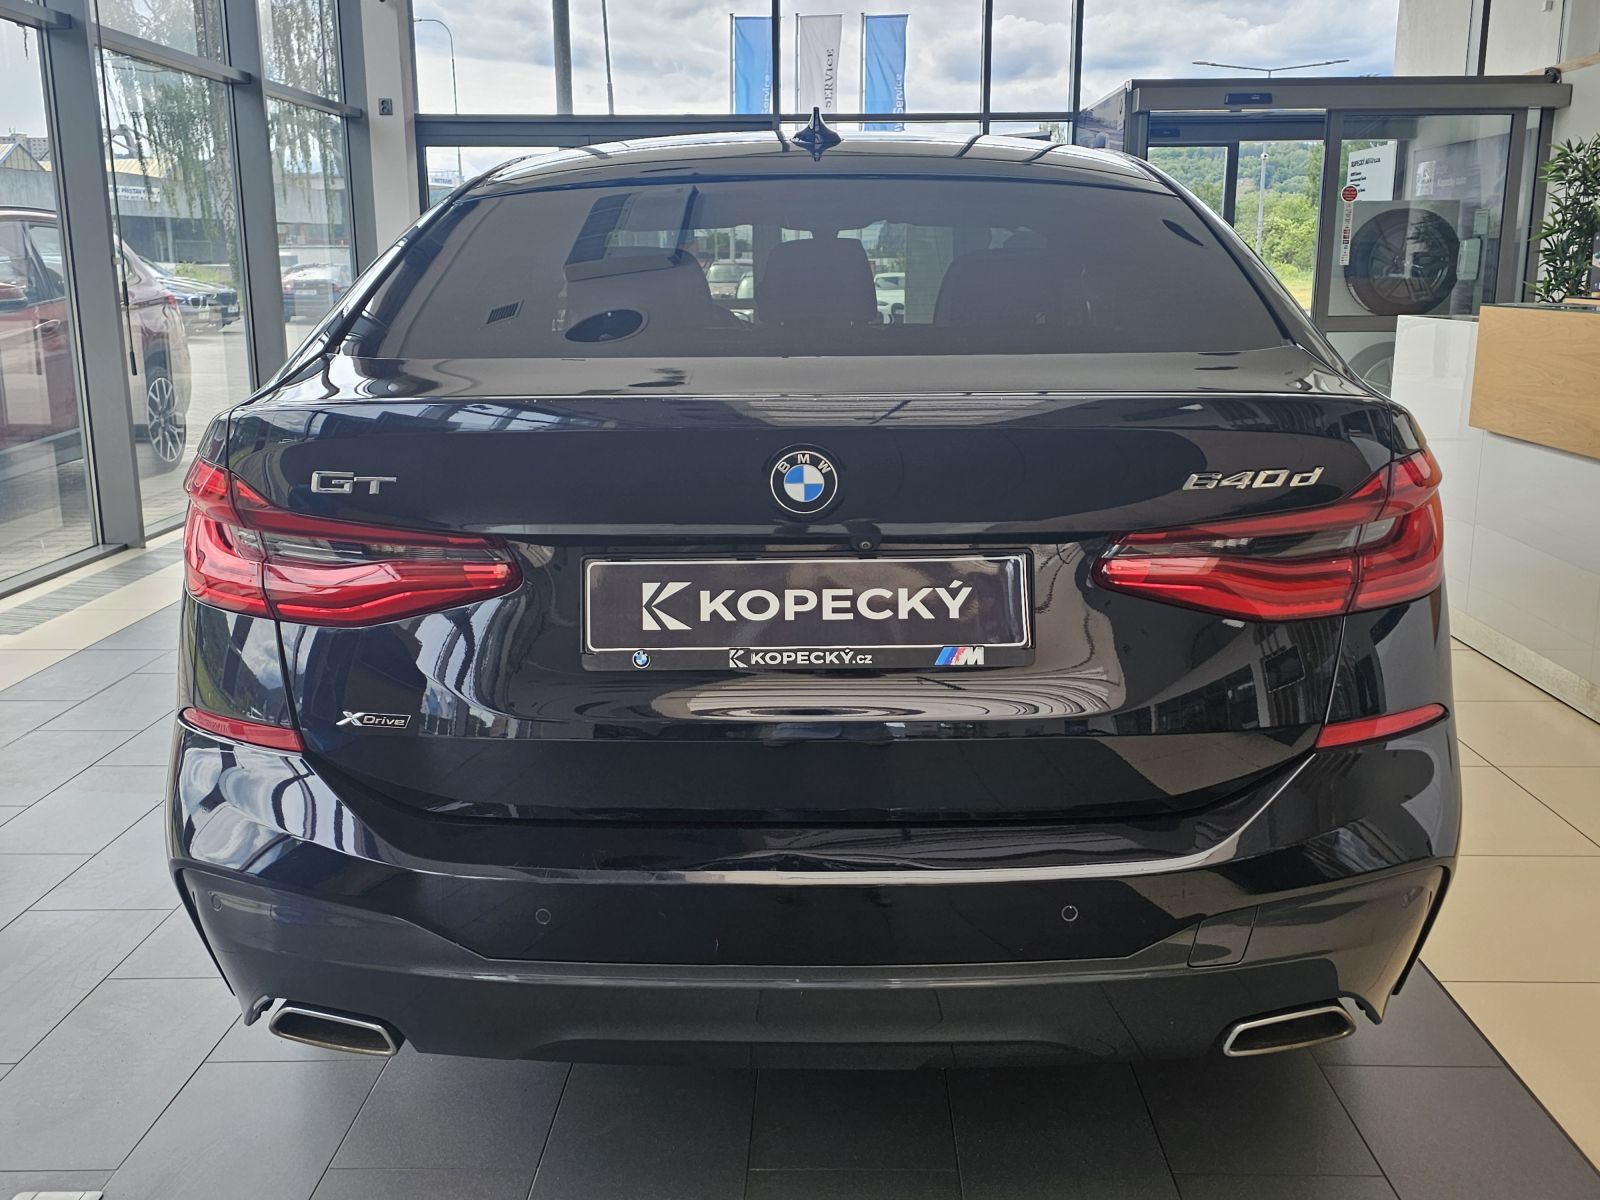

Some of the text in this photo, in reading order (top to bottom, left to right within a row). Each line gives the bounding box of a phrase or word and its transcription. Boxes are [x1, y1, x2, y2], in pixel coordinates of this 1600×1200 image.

[823, 48, 835, 108] SERVICE
[892, 73, 904, 114] Service
[777, 453, 832, 474] BMW
[310, 470, 397, 495] GT
[1181, 466, 1325, 491] 640d
[699, 580, 974, 622] KOPECKÝ
[750, 648, 873, 665] KOPECKÝ.cz
